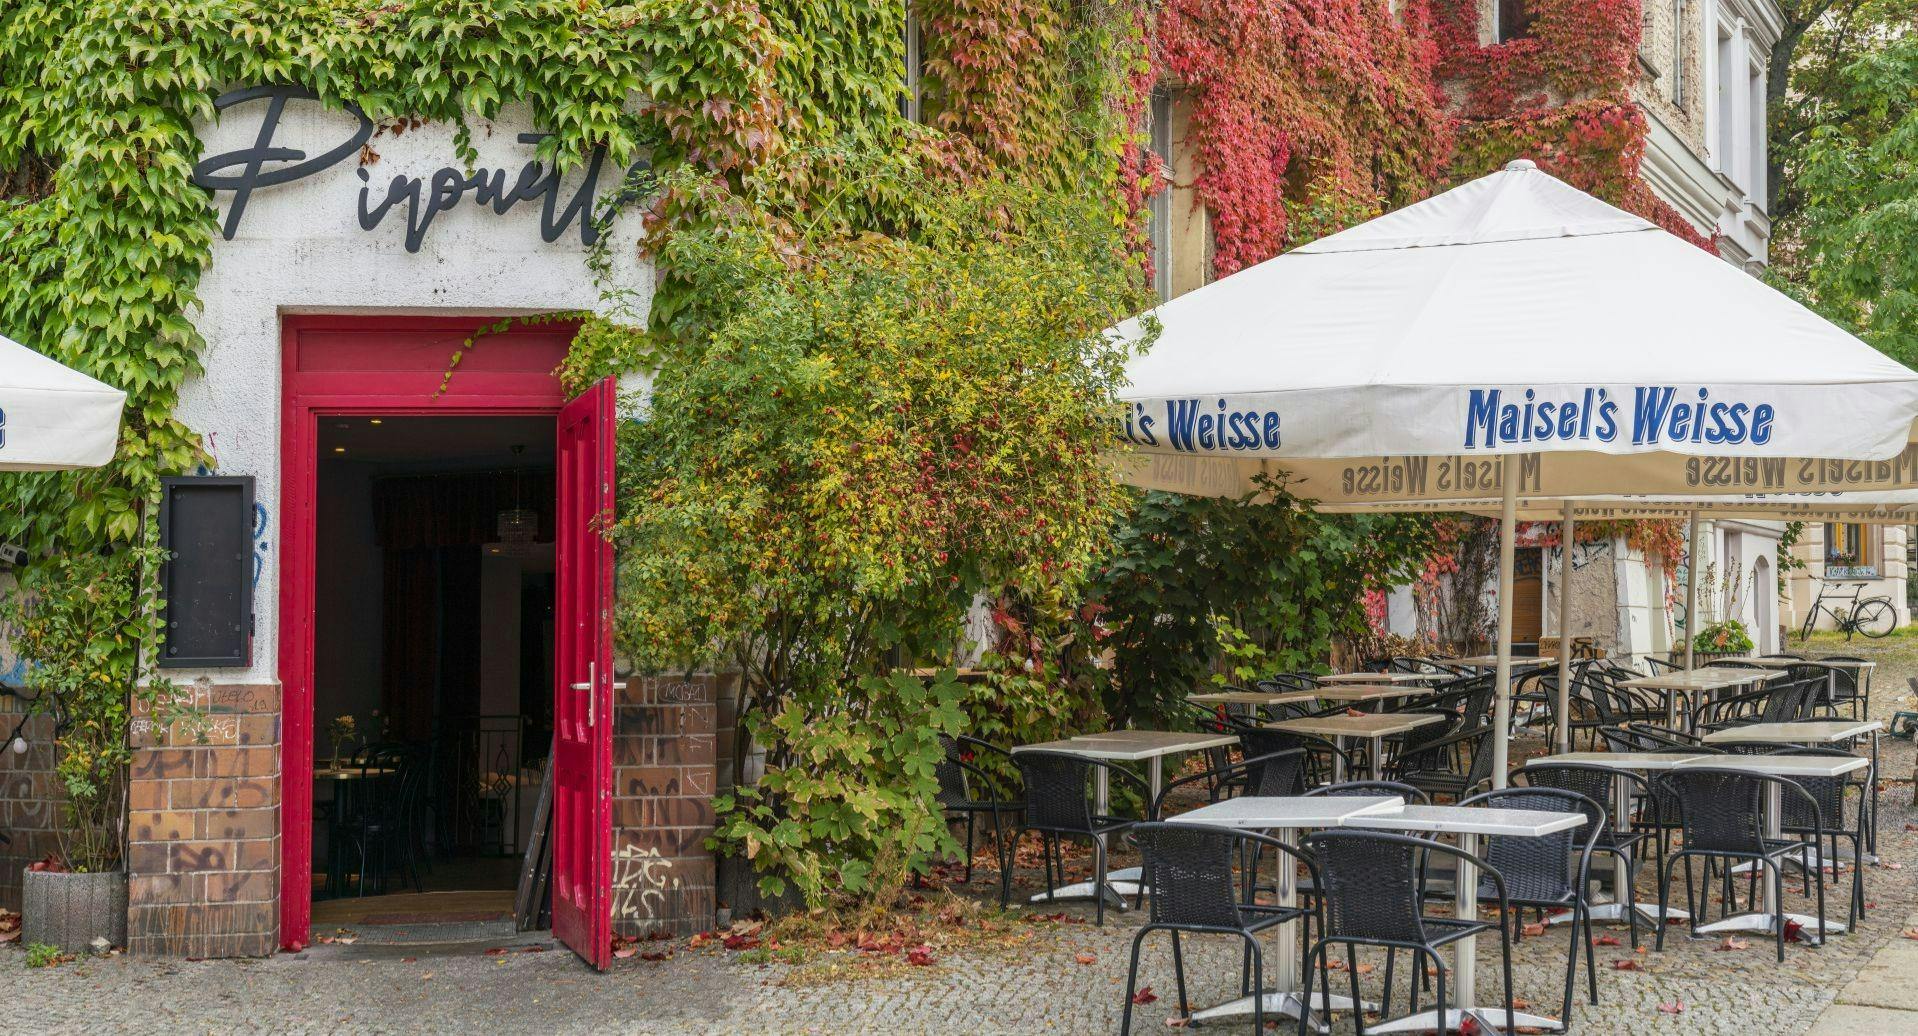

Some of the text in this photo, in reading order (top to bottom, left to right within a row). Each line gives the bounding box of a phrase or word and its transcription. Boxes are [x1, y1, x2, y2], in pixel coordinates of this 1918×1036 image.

[1166, 398, 1281, 453] Weisse
[1464, 386, 1776, 449] Maisel's Weisse
